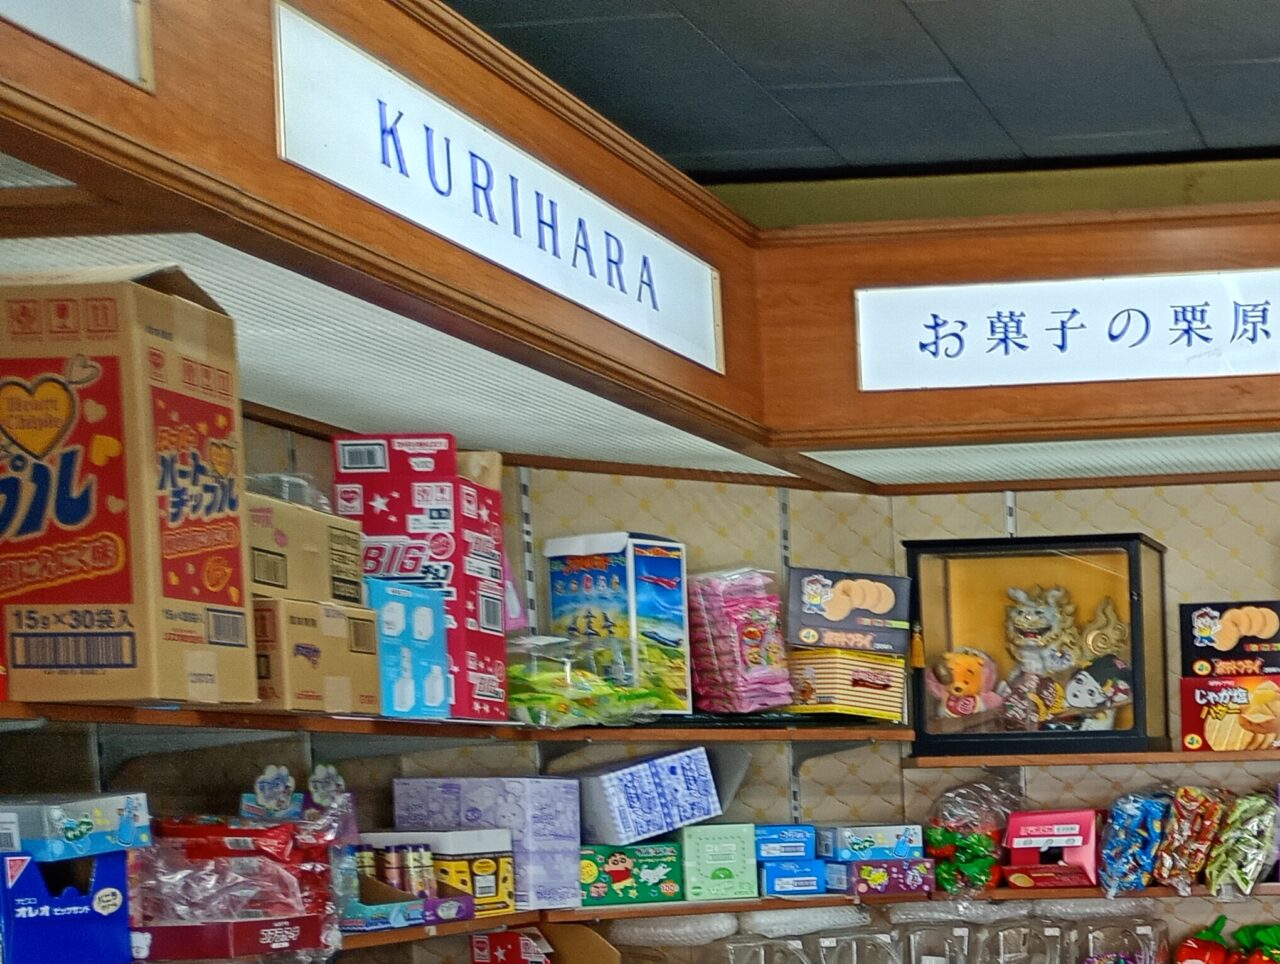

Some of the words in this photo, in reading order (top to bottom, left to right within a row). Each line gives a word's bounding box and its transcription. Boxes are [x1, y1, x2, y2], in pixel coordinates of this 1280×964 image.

[376, 97, 661, 313] KURIHARA
[918, 299, 1273, 360] お菓子の栗原
[363, 544, 422, 574] BIG
[13, 610, 135, 630] 15g×30袋入
[1195, 687, 1250, 705] じゃが塩
[15, 904, 51, 919] オレオ
